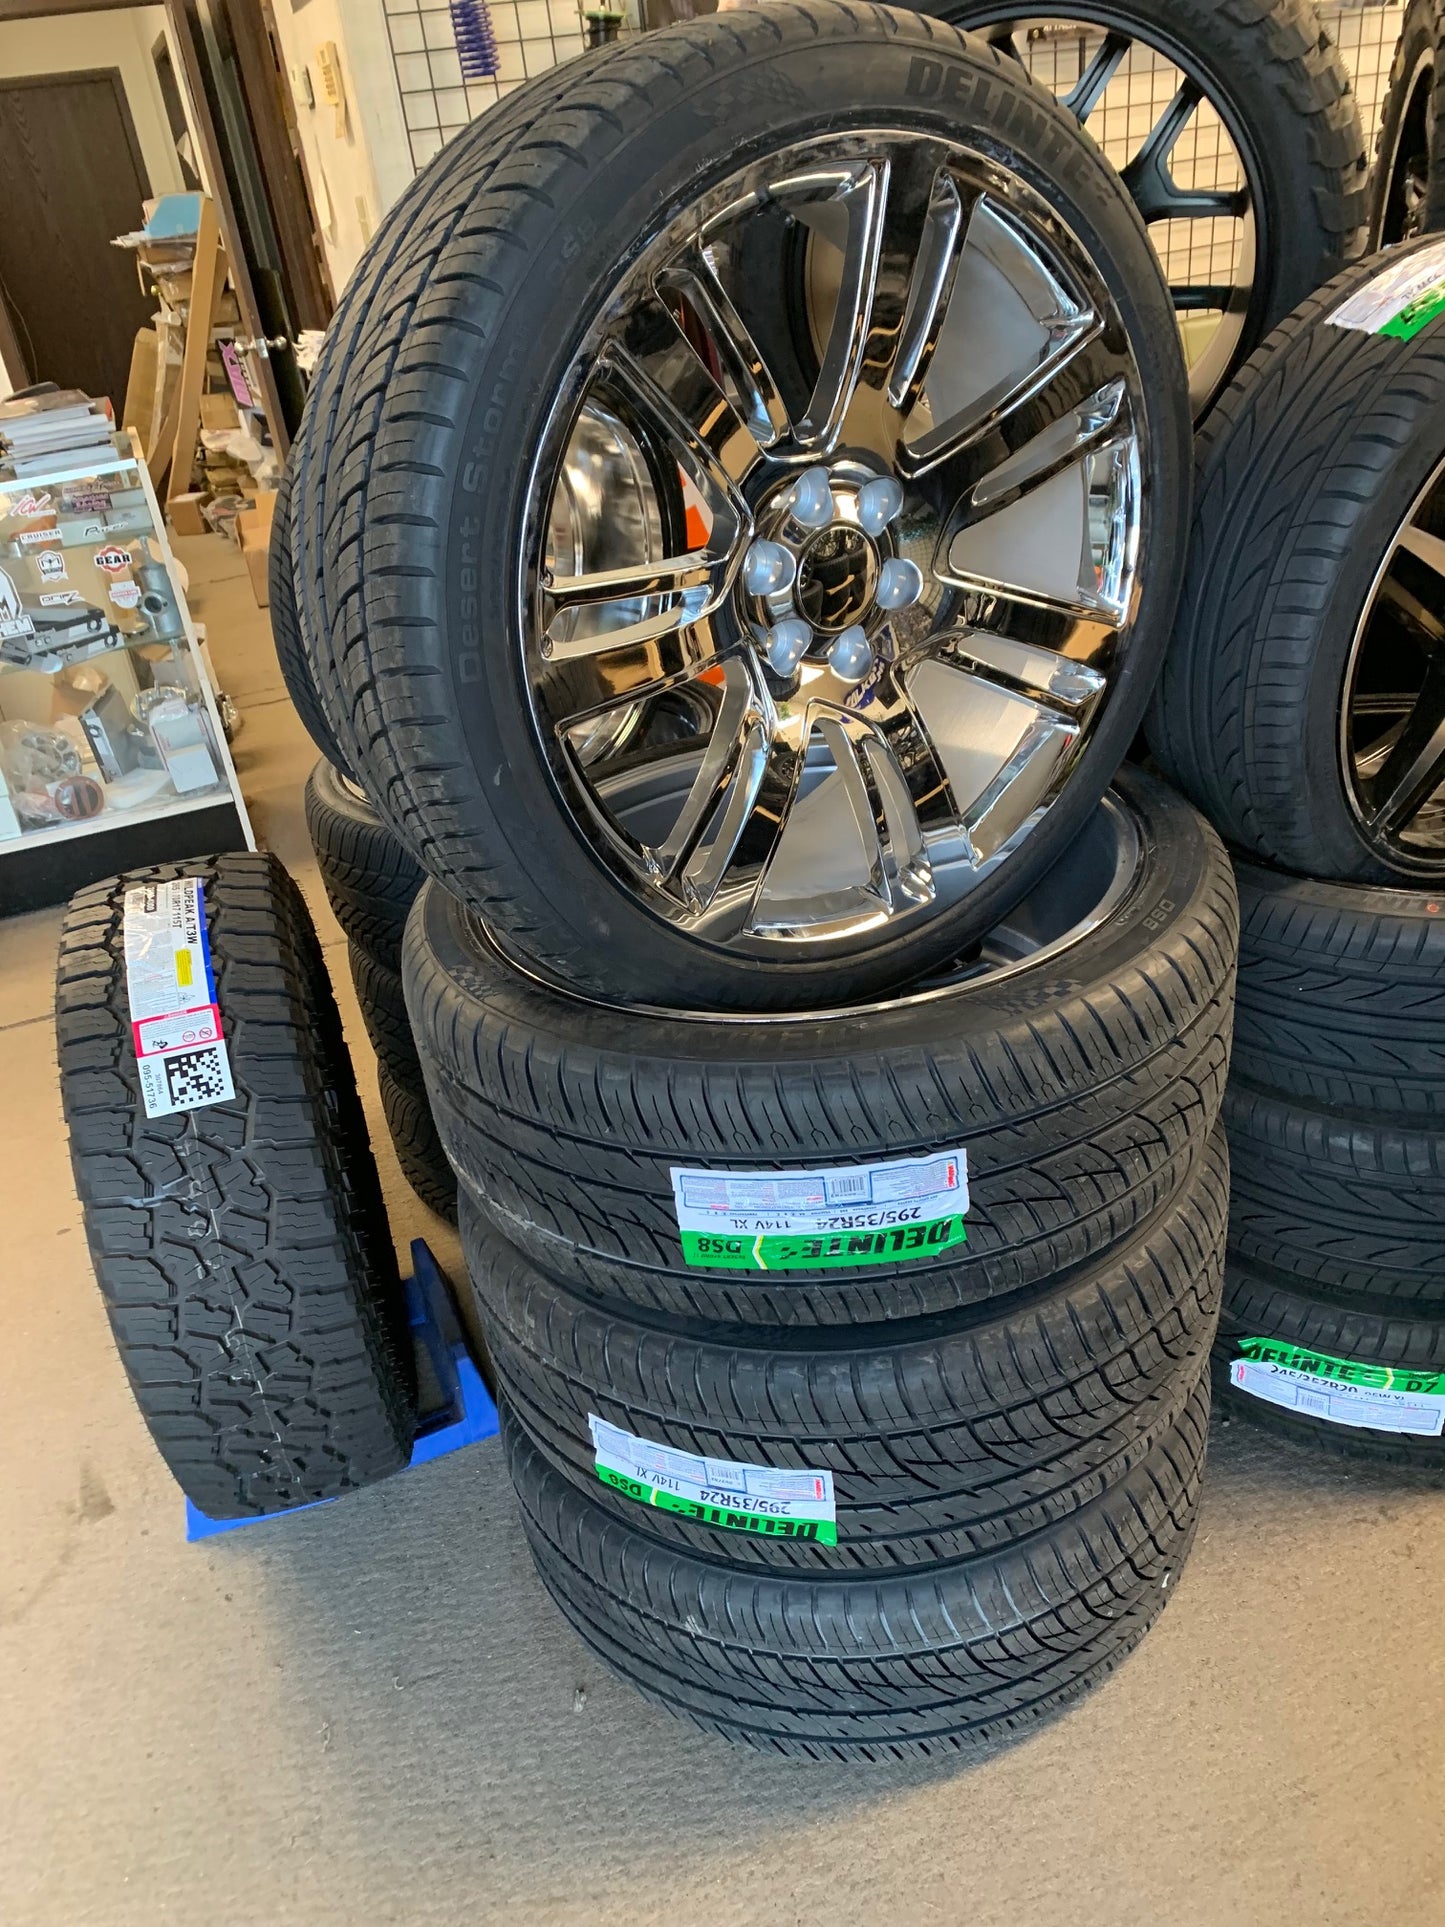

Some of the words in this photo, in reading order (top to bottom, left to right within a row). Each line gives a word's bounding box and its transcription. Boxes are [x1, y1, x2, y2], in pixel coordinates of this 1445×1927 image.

[462, 341, 524, 493] Storm
[96, 554, 130, 565] GEAR
[459, 516, 482, 683] Desert
[142, 1064, 157, 1109] 095-51736
[730, 1218, 748, 1229] XL
[755, 1218, 791, 1230] 114V
[817, 1205, 922, 1230] 295/35R24
[697, 1238, 742, 1253] DS8
[802, 1219, 953, 1260] DELINTE
[1405, 1380, 1439, 1394] D7
[636, 1466, 648, 1479] XL
[651, 1473, 679, 1491] 114V
[700, 1490, 791, 1515] 295/35R24
[689, 1504, 819, 1539] DELINTE
